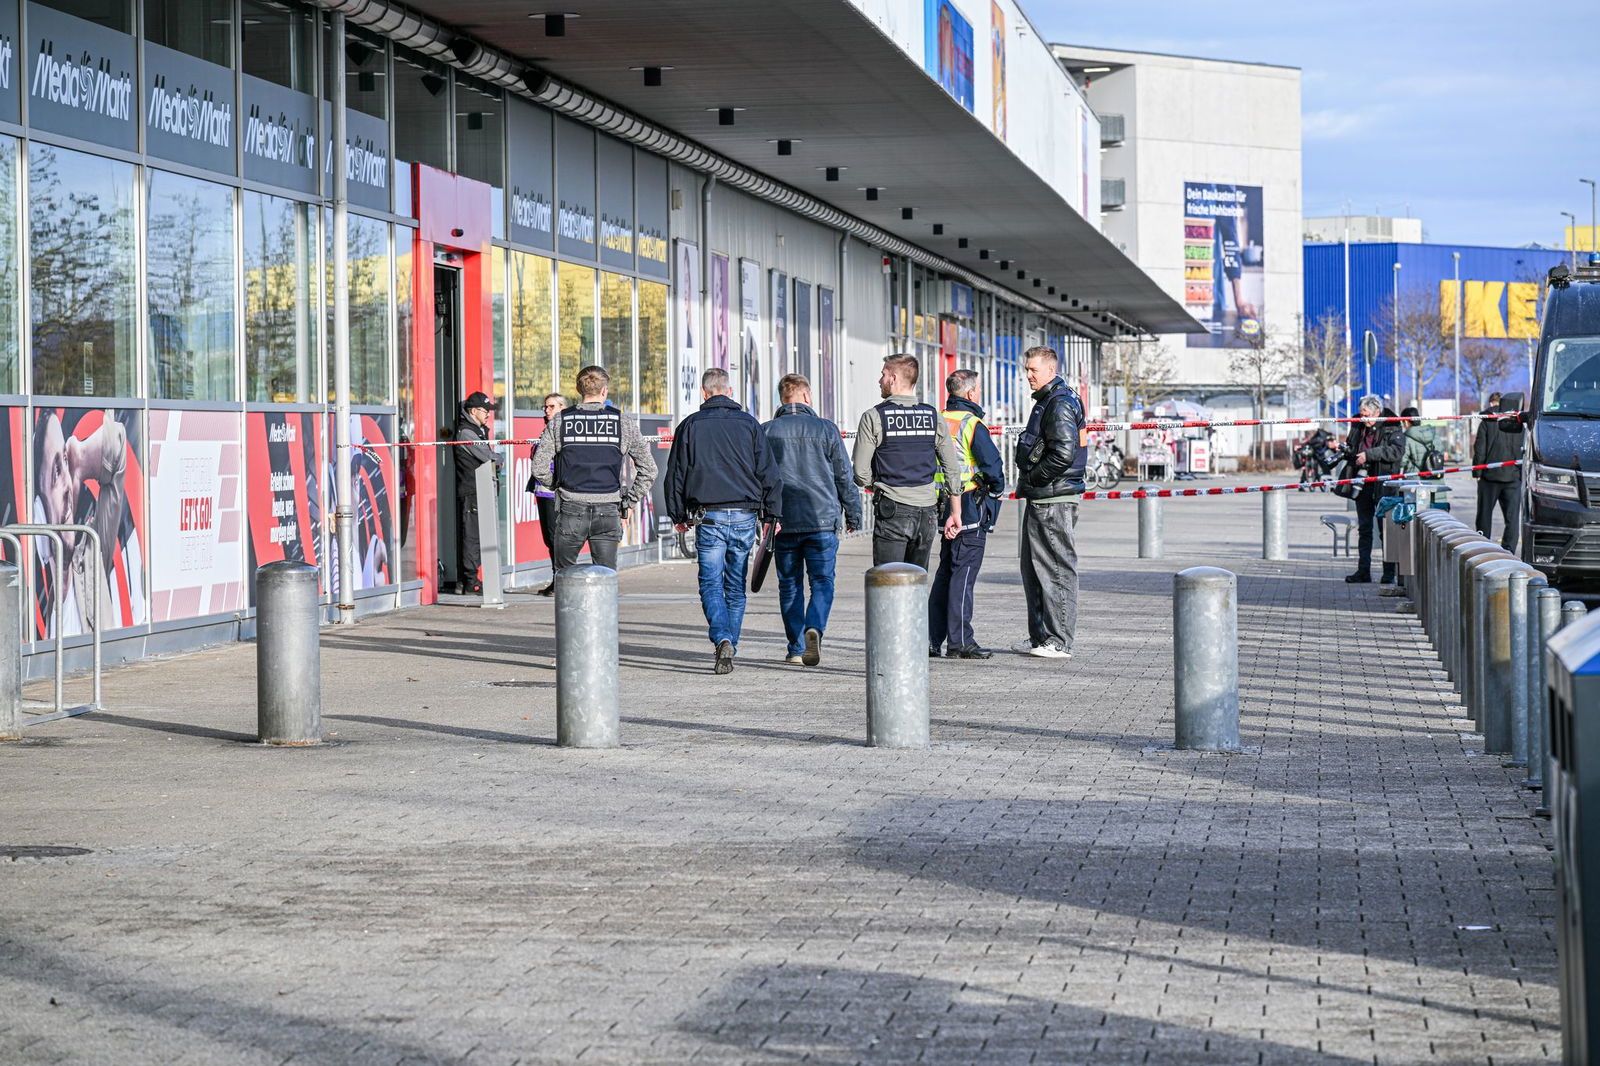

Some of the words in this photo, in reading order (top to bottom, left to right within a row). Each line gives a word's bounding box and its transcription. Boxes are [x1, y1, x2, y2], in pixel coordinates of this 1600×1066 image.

[1187, 187, 1202, 200] Dein
[1440, 279, 1541, 339] IKE
[565, 420, 618, 436] POLIZEI
[887, 416, 934, 429] POLIZEI
[180, 497, 199, 531] LET'S
[200, 496, 213, 530] GO!
